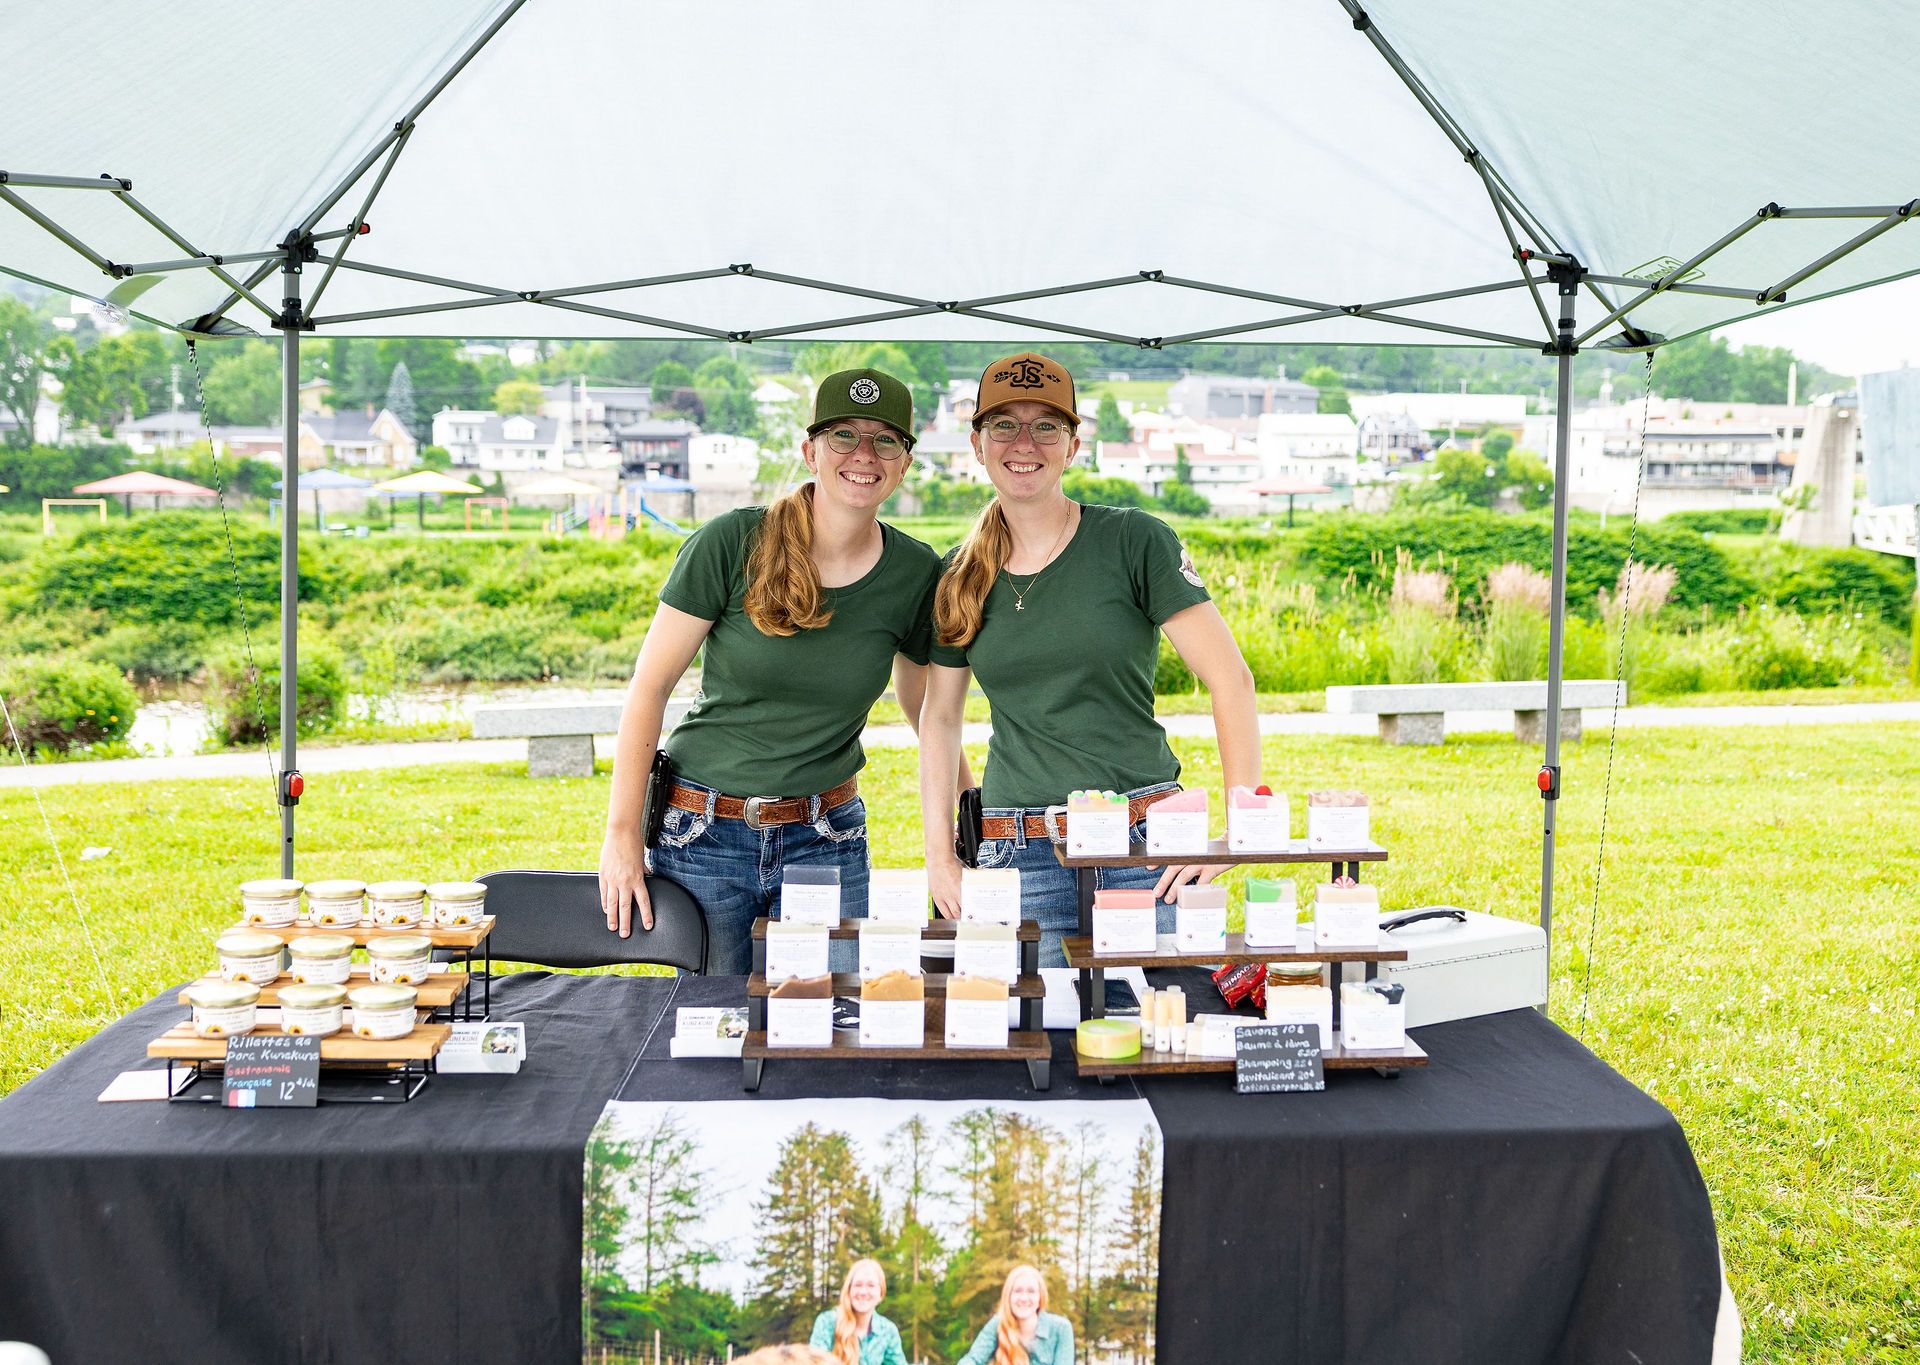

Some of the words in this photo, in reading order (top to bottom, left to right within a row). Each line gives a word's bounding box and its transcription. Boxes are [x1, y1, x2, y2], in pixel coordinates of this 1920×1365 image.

[1012, 364, 1042, 383] JS
[1236, 1027, 1278, 1039] Savons
[229, 1036, 291, 1049] Rillettes
[295, 1037, 312, 1047] de
[1237, 1058, 1292, 1070] Shampoing
[226, 1064, 291, 1077] Gastronomie
[1238, 1070, 1295, 1083] Revitalisant
[226, 1078, 273, 1089] Française
[1239, 1082, 1270, 1093] Lotion
